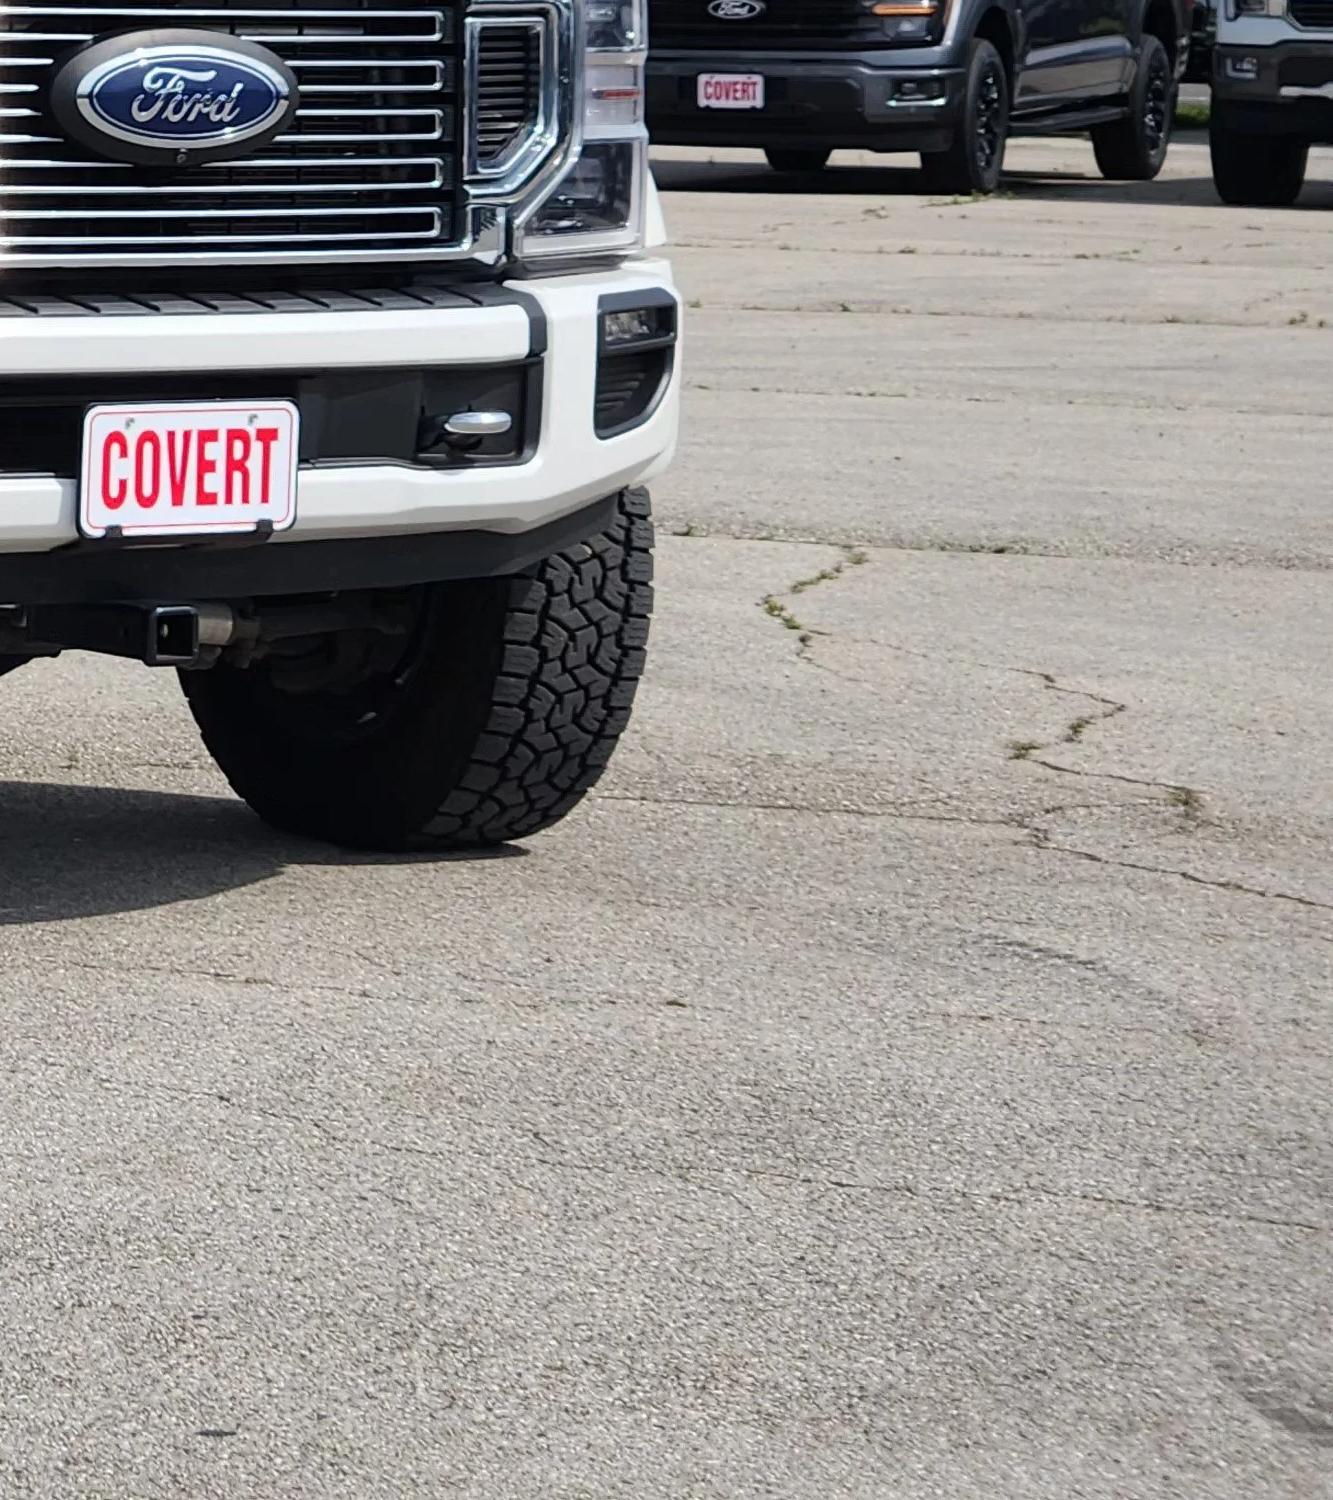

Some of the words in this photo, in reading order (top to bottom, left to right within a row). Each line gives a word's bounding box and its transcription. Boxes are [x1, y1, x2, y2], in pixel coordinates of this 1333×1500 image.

[718, 1, 750, 15] Ford
[131, 67, 244, 123] Ford
[703, 80, 758, 101] COVERT
[101, 427, 279, 510] COVERT
